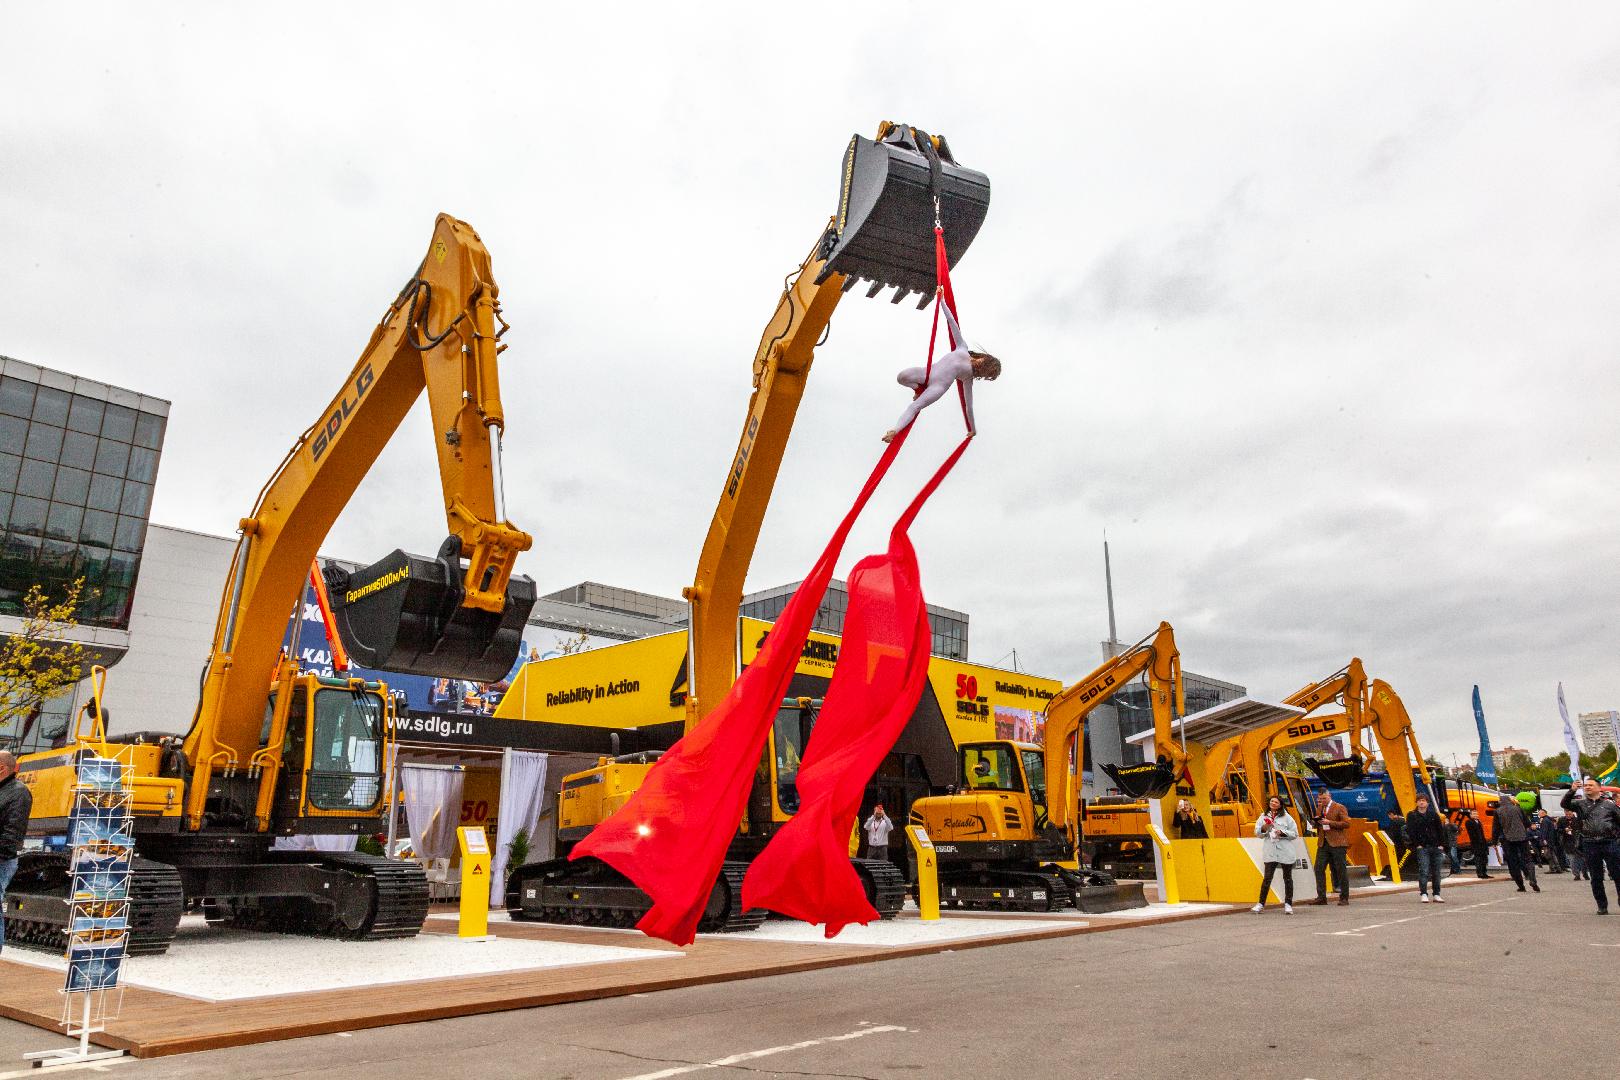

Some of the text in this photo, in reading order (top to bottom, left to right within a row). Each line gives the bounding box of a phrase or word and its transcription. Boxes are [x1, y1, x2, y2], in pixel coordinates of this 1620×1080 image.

[312, 362, 374, 463] SDLG
[728, 415, 759, 500] SDLG
[546, 679, 640, 707] Reliability in Action
[956, 673, 977, 700] 50
[995, 681, 1054, 700] Reliability in Action
[1080, 675, 1115, 704] SDLG
[1297, 694, 1320, 708] DLG
[1287, 720, 1336, 738] SDLG
[461, 800, 488, 822] 50
[943, 818, 976, 829] Reliable
